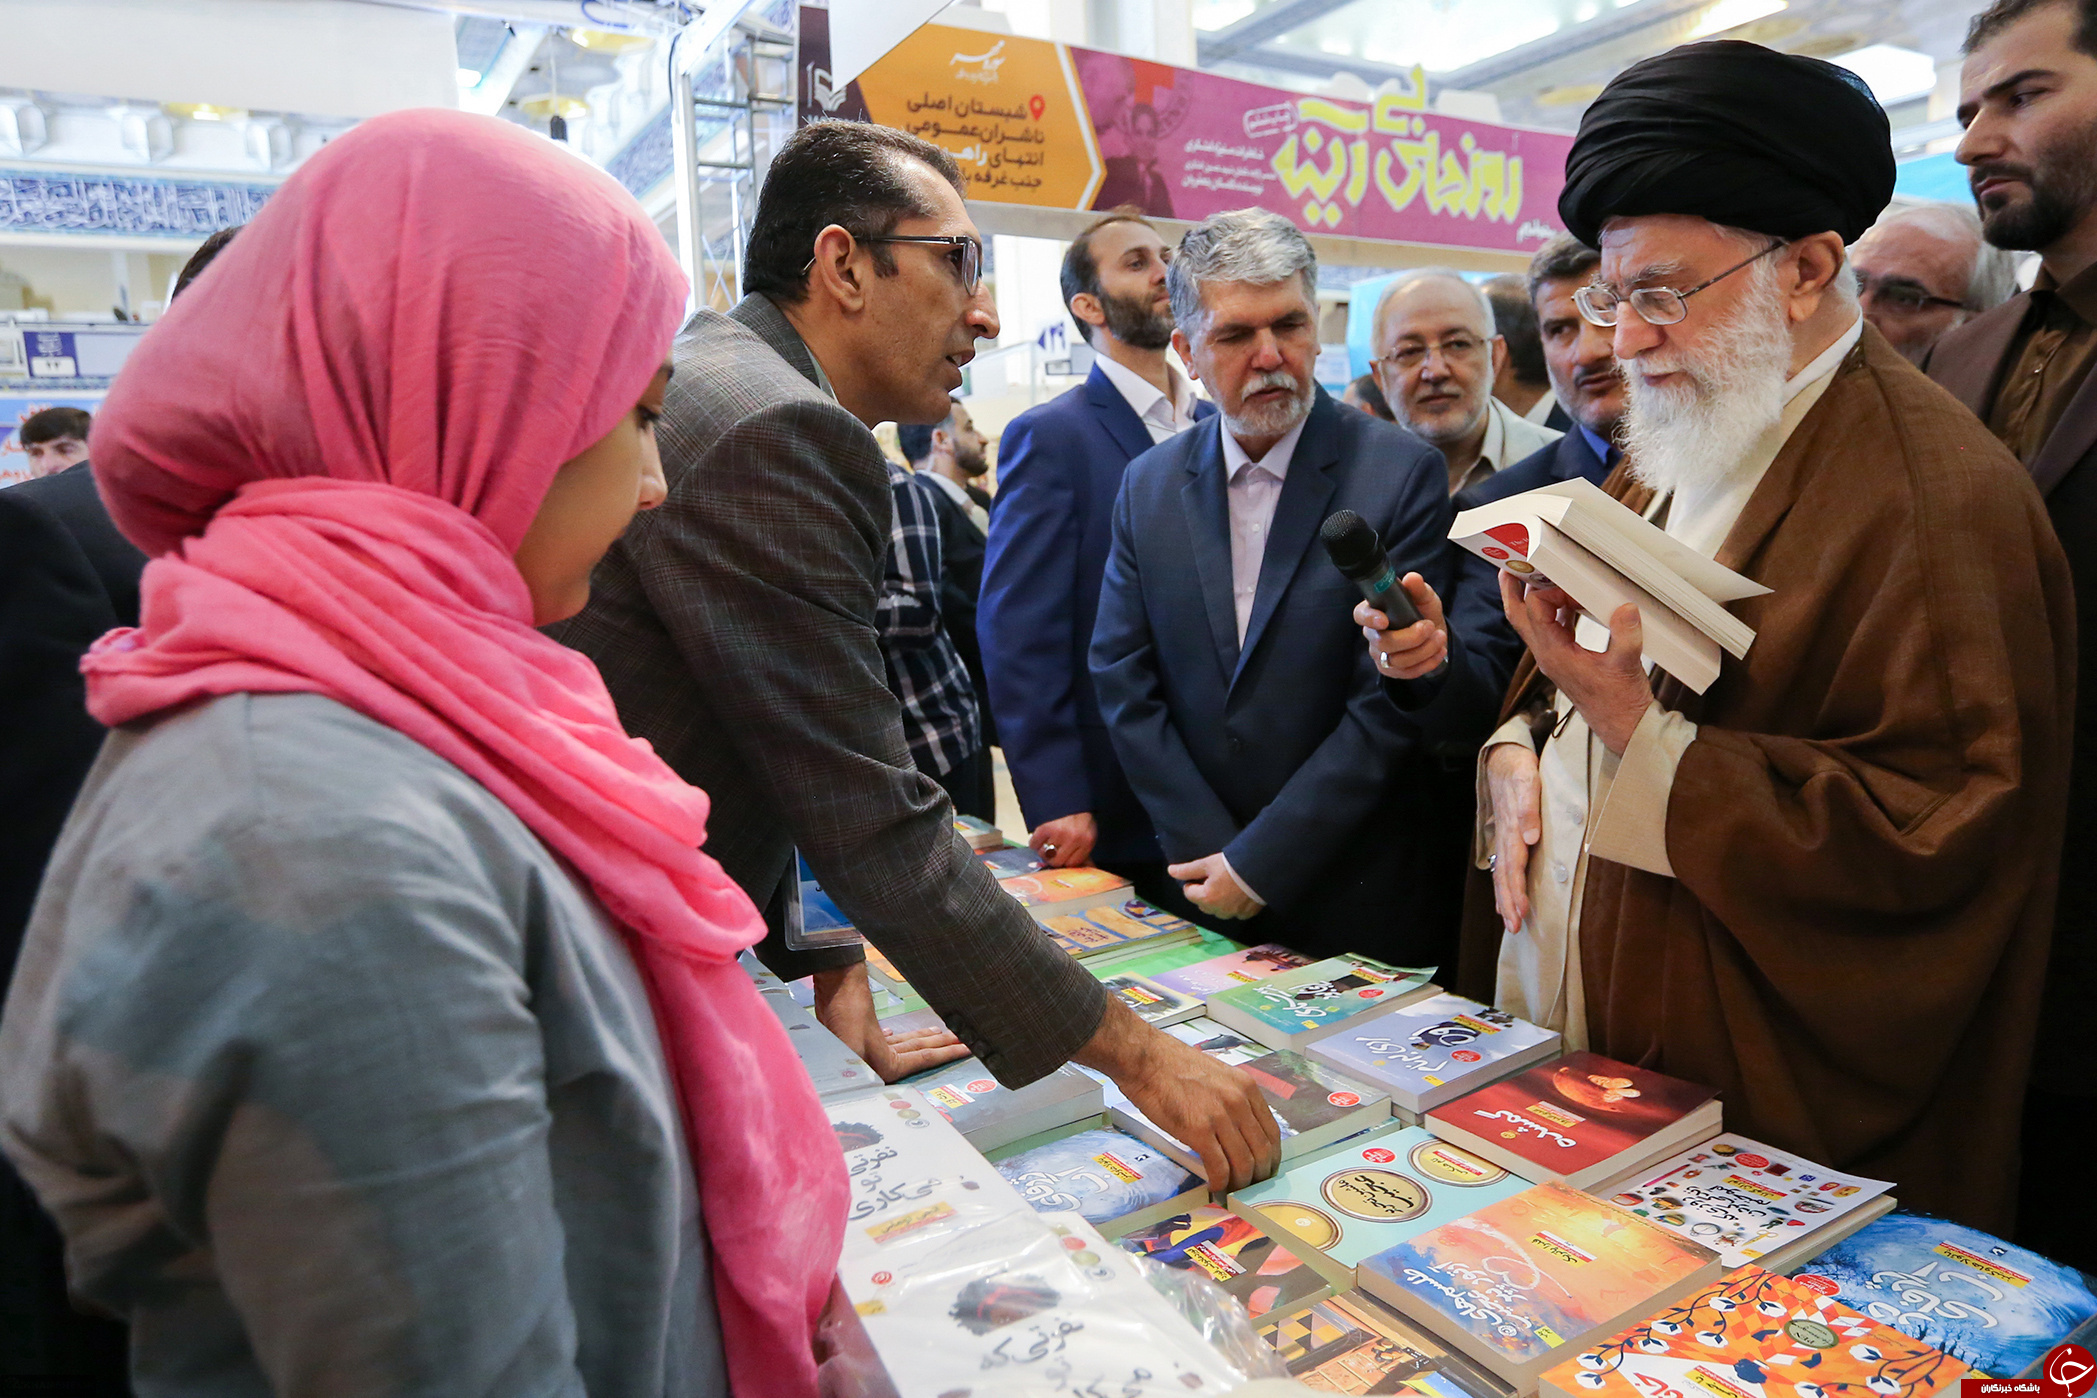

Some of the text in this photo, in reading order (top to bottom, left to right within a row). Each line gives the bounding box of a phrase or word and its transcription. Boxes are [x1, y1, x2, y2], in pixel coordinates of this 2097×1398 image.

[906, 93, 1027, 121] شبستان اصلی
[906, 122, 1045, 145] ناشران عمومی
[988, 149, 1044, 168] انتهای
[1270, 63, 1524, 230] روزهای بی آینه
[974, 172, 1013, 188] غرفه
[1013, 177, 1043, 189] جنب
[1473, 1109, 1577, 1148] گمشده
[860, 1172, 883, 1194] تو
[1045, 1165, 1110, 1194] آب
[1354, 1174, 1415, 1209] عجیب
[1338, 1179, 1404, 1214] ماشین تحریر
[1708, 1185, 1772, 1205] آموختم
[1682, 1196, 1739, 1221] روزی که
[1547, 1245, 1578, 1264] پاتریک
[1426, 1261, 1495, 1286] آرتور
[1899, 1261, 2004, 1302] آب
[1403, 1268, 1533, 1329] طلسم‌های عجیب
[1865, 1270, 1999, 1328] ژرفای
[1867, 1301, 1937, 1325] در
